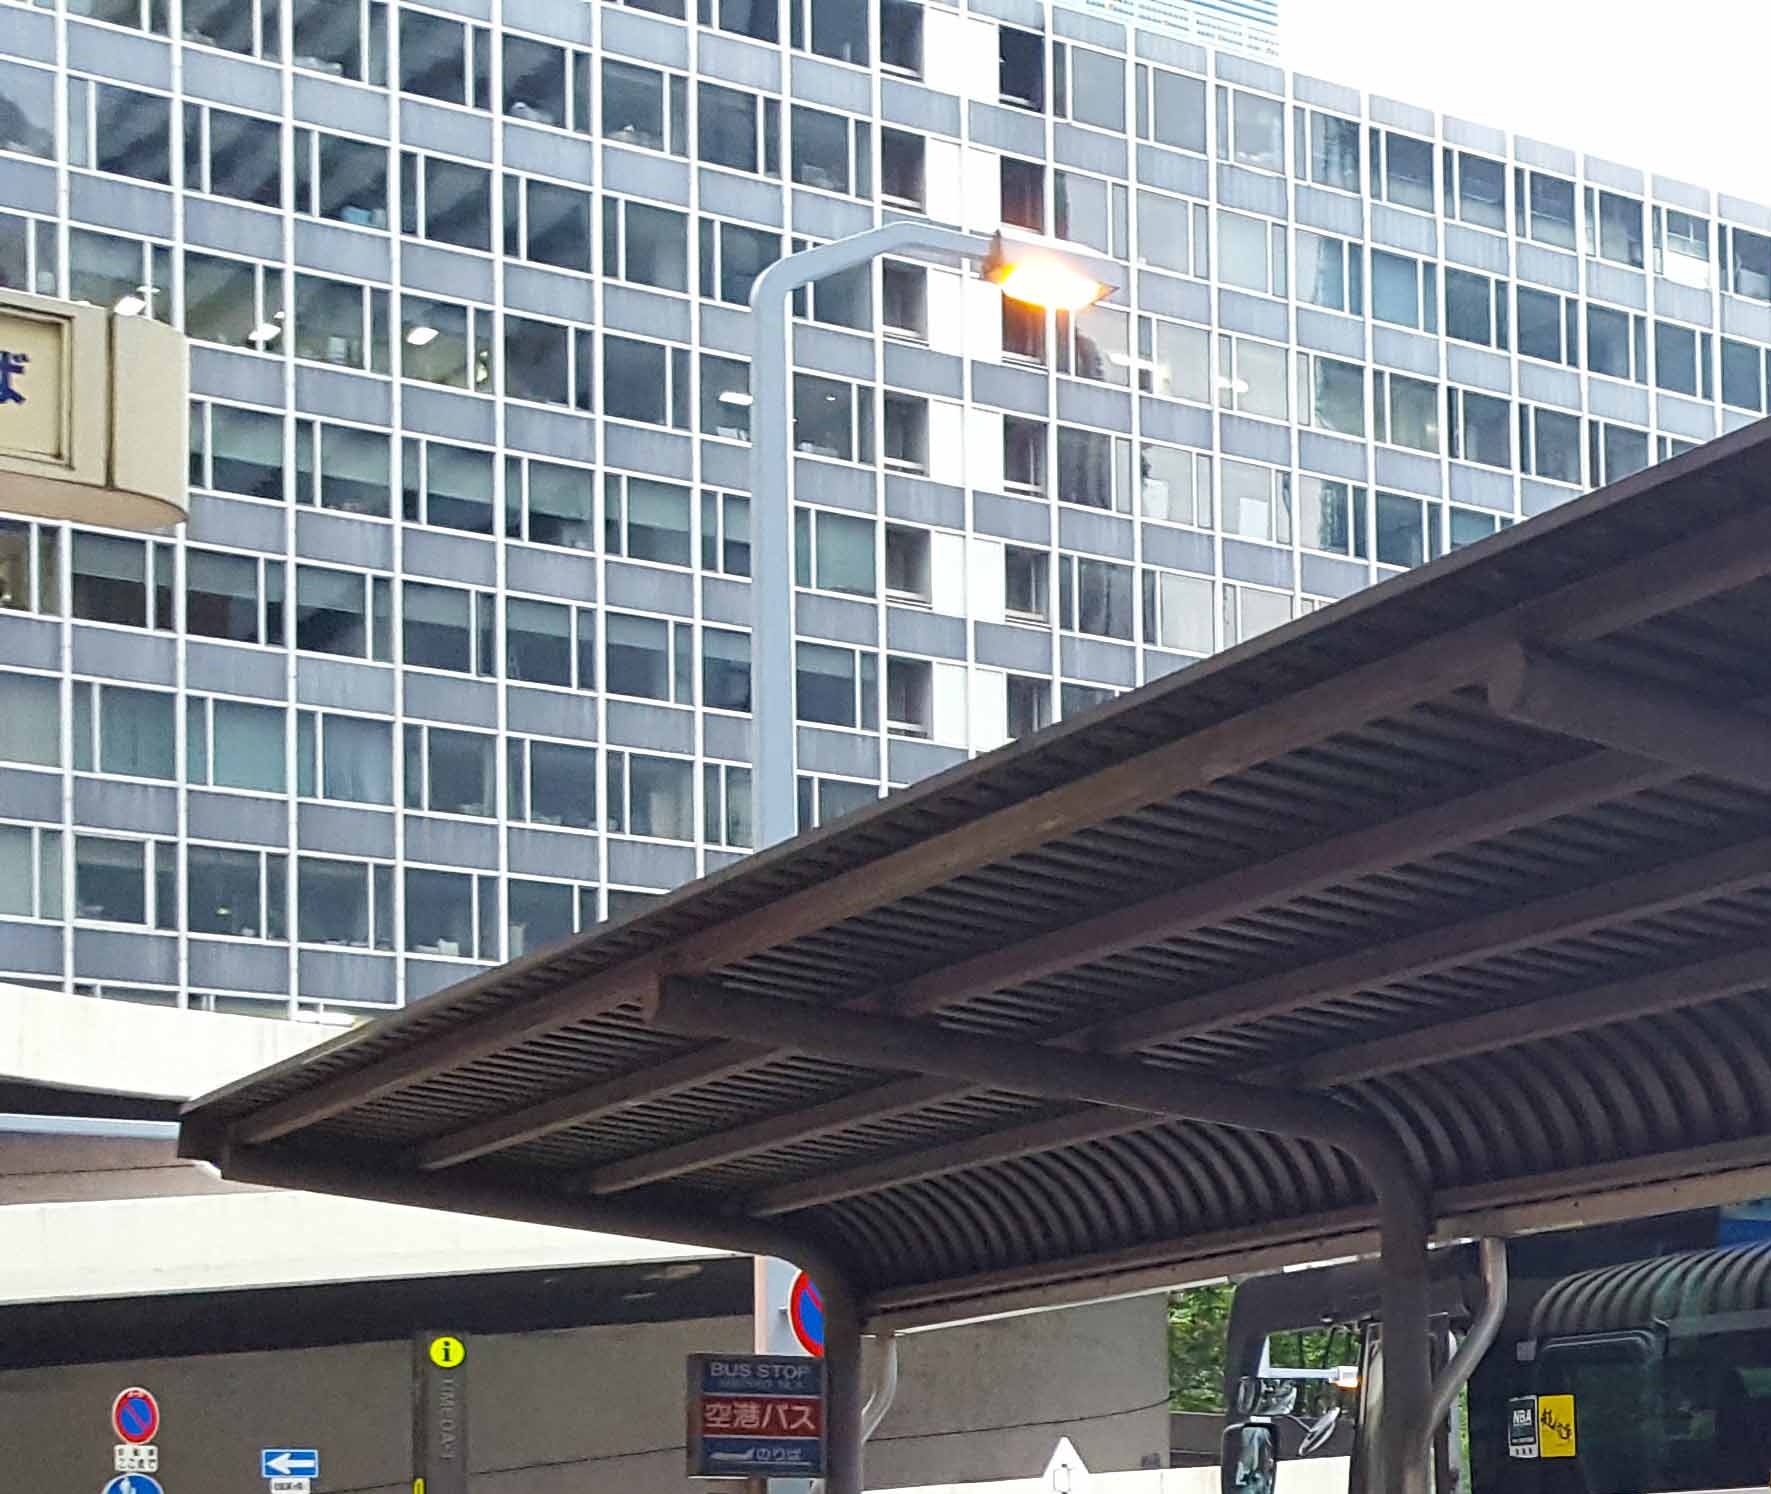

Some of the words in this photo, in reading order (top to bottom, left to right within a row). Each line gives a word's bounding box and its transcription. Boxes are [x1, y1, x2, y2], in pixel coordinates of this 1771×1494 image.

[710, 1362, 752, 1377] BUS
[757, 1364, 811, 1379] STOP
[705, 1402, 815, 1430] 空港バス
[756, 1448, 802, 1461] のりば
